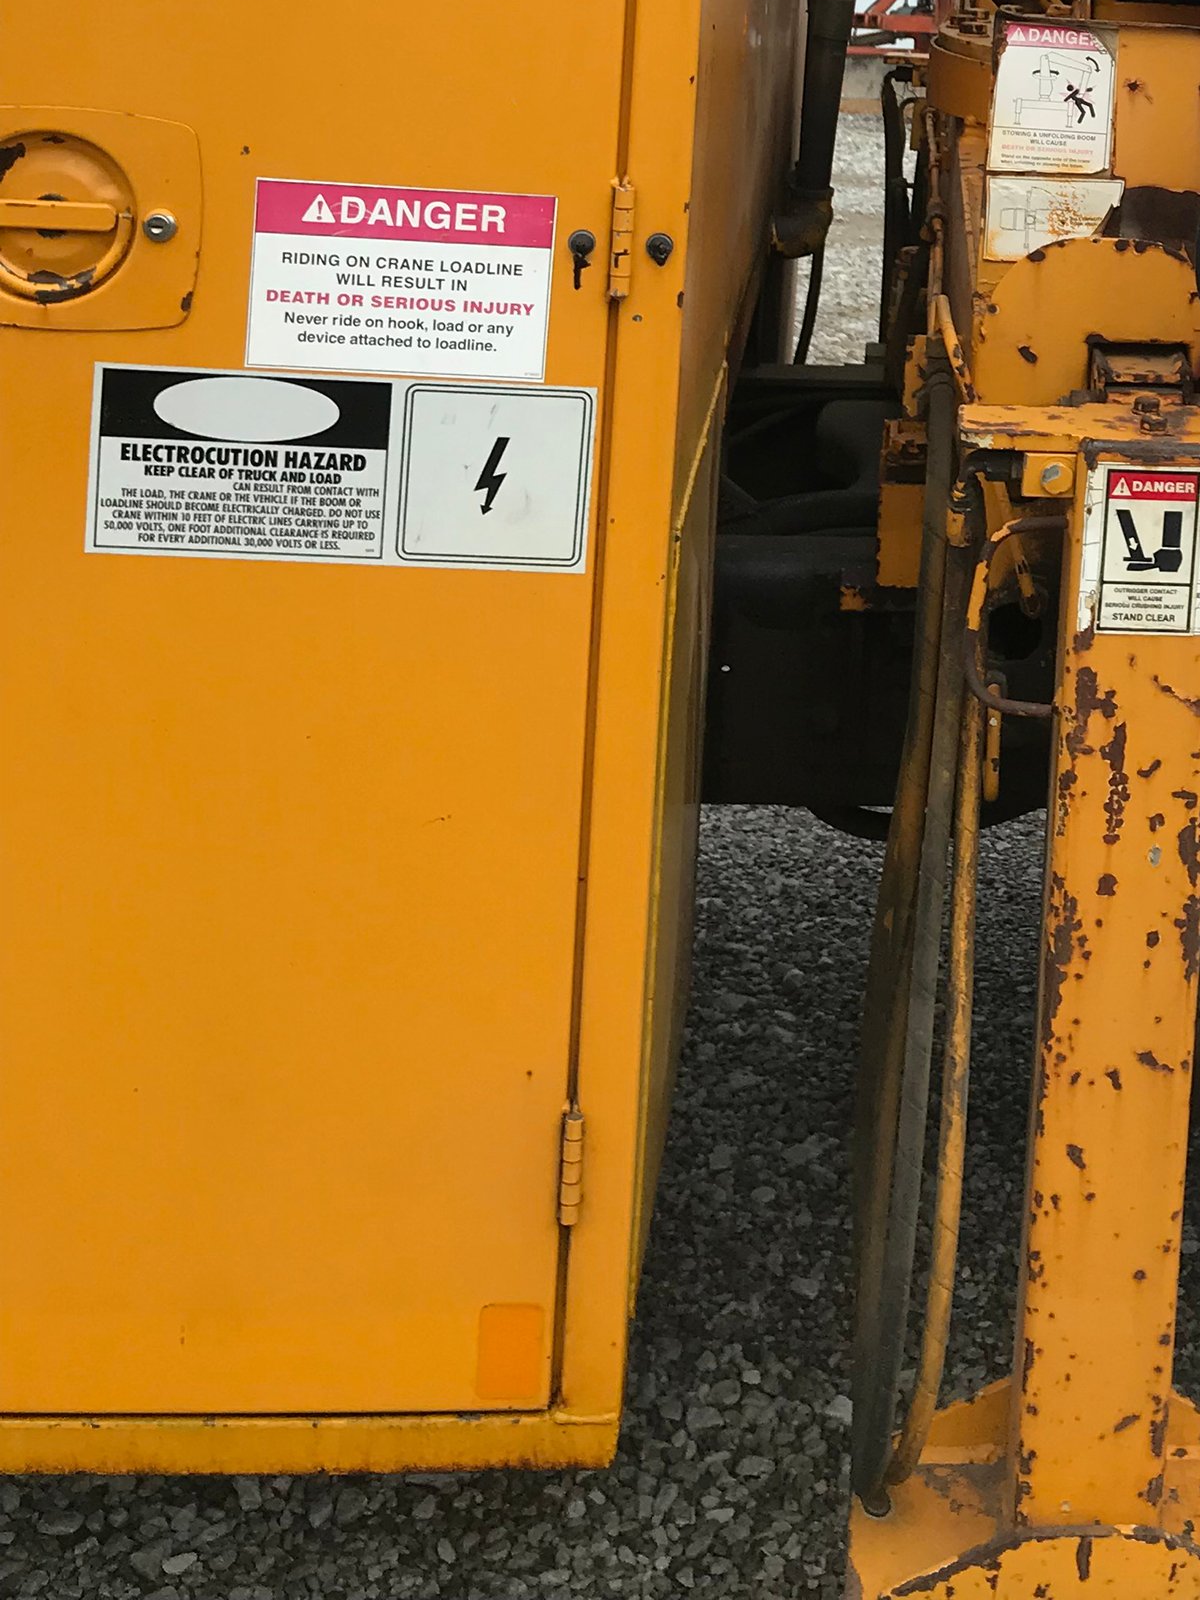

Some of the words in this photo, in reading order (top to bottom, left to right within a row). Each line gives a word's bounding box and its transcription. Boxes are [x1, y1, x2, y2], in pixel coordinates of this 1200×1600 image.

[1028, 28, 1096, 46] DANGE
[341, 196, 506, 233] DANGER
[282, 252, 340, 267] RIDING
[346, 255, 370, 268] ON
[376, 257, 434, 272] CRANE
[440, 261, 523, 276] LOADLINE
[336, 273, 376, 286] WILL
[382, 275, 445, 290] RESULT
[451, 279, 467, 291] IN
[266, 290, 330, 305] DEATH
[337, 294, 364, 307] OR
[371, 295, 456, 312] SERIOUS
[463, 301, 534, 316] INJURY
[284, 312, 328, 325] Never
[333, 314, 361, 327] ride
[365, 319, 383, 328] on
[388, 317, 428, 332] hook,
[433, 320, 464, 332] load
[468, 324, 483, 333] or
[487, 325, 514, 338] any
[298, 330, 346, 344] device
[350, 333, 413, 348] attached
[417, 337, 431, 349] to
[436, 337, 497, 352] loadline.
[120, 443, 279, 468] ELECTROCUTION
[285, 451, 367, 473] HAZARD
[144, 465, 175, 477] KEEP
[178, 466, 216, 479] CLEAR
[219, 468, 234, 480] OF
[237, 469, 277, 482] TRUCK
[280, 471, 306, 483] AND
[310, 473, 342, 485] LOAD
[121, 488, 137, 497] THE
[140, 489, 167, 500] LOAD,
[169, 490, 185, 499] THE
[188, 491, 217, 501] CRANE
[219, 492, 232, 502] OR
[235, 493, 250, 503] THE
[253, 494, 288, 504] VEHICLE
[291, 496, 298, 505] IF
[300, 497, 317, 506] THE
[319, 497, 347, 507] BOOM
[349, 498, 361, 508] OR
[233, 482, 251, 492] CAN
[254, 483, 284, 493] RESULT
[287, 485, 312, 495] FROM
[314, 486, 353, 497] CONTACT
[356, 488, 379, 497] WITH
[1132, 481, 1195, 494] DANGER
[101, 498, 143, 509] LOADLINE
[146, 500, 182, 511] SHOULD
[185, 502, 220, 512] BECOME
[222, 503, 280, 515] ELECTRICALLY
[282, 506, 326, 518] CHARGED.
[329, 508, 342, 518] DO
[345, 509, 363, 519] NOT
[365, 510, 380, 519] USE
[112, 509, 141, 520] CRANE
[144, 511, 178, 521] WITHIN
[181, 513, 191, 522] 10
[193, 513, 212, 523] FEET
[214, 514, 226, 523] OF
[228, 515, 266, 525] ELECTRIC
[269, 516, 293, 526] LINES
[294, 518, 340, 529] CARRYING
[342, 520, 355, 529] UP
[357, 520, 368, 530] TO
[104, 520, 133, 531] 50,000
[135, 522, 165, 533] VOLTS,
[168, 523, 186, 533] ONE
[189, 524, 211, 534] FOOT
[213, 525, 267, 536] ADDITIONAL
[269, 528, 319, 539] CLEARANCE
[320, 529, 329, 539] IS
[332, 530, 375, 541] REQUIRED
[138, 533, 155, 543] FOR
[158, 533, 185, 544] EVERY
[188, 535, 242, 546] ADDITIONAL
[244, 537, 273, 548] 30,000
[275, 539, 303, 549] VOLTS
[304, 540, 317, 549] OR
[320, 541, 341, 550] LESS.
[1112, 613, 1143, 621] STAND
[1145, 614, 1175, 622] CLEAR
